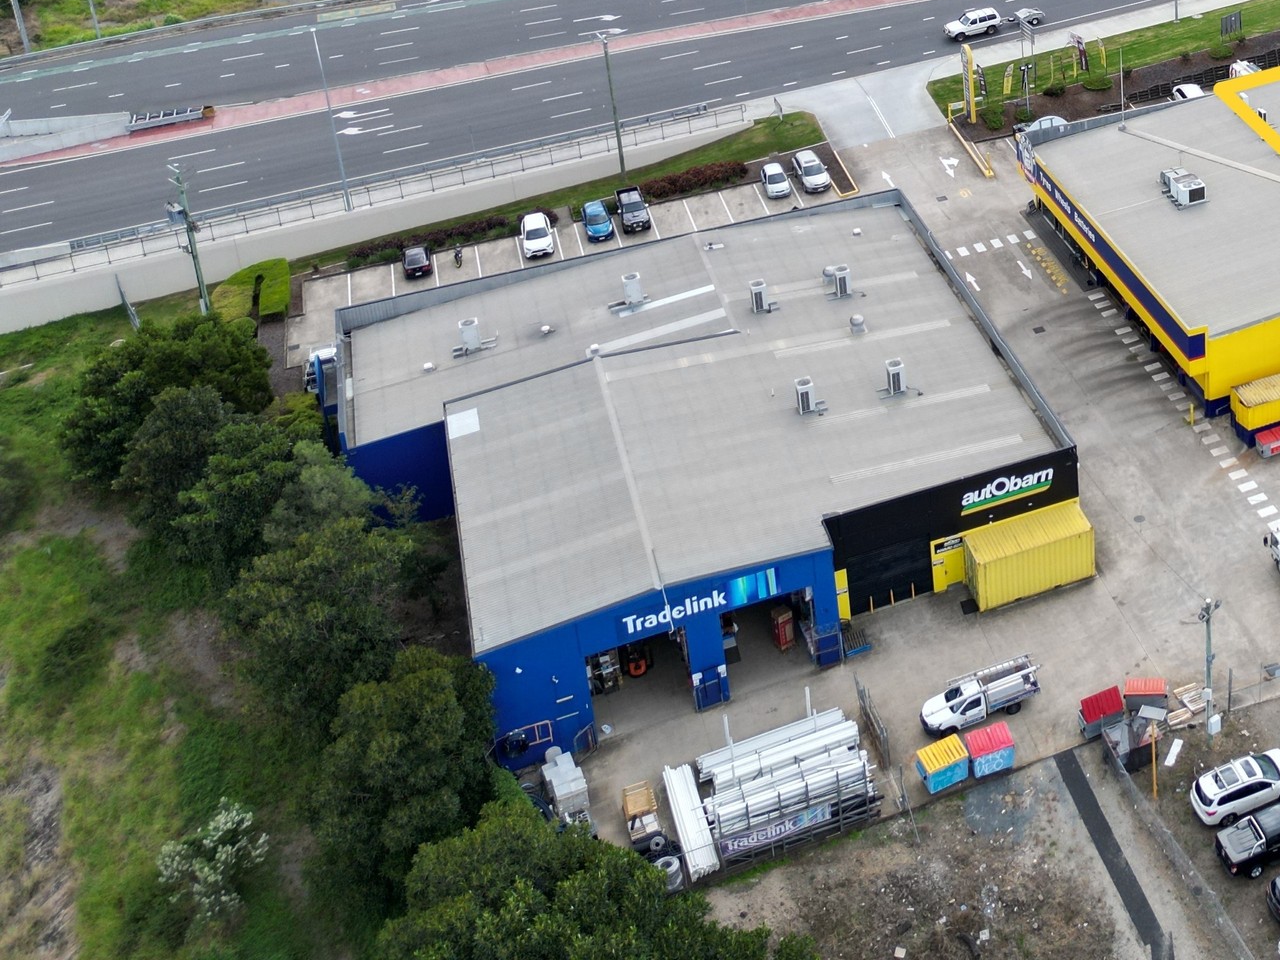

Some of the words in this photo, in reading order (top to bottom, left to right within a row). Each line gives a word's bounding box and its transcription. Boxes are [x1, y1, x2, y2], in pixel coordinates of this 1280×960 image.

[1039, 171, 1052, 192] Tyres
[1054, 188, 1071, 215] Wheels
[1074, 211, 1096, 243] Batteries
[622, 589, 727, 634] Tradelink
[725, 819, 795, 851] Tradelink
